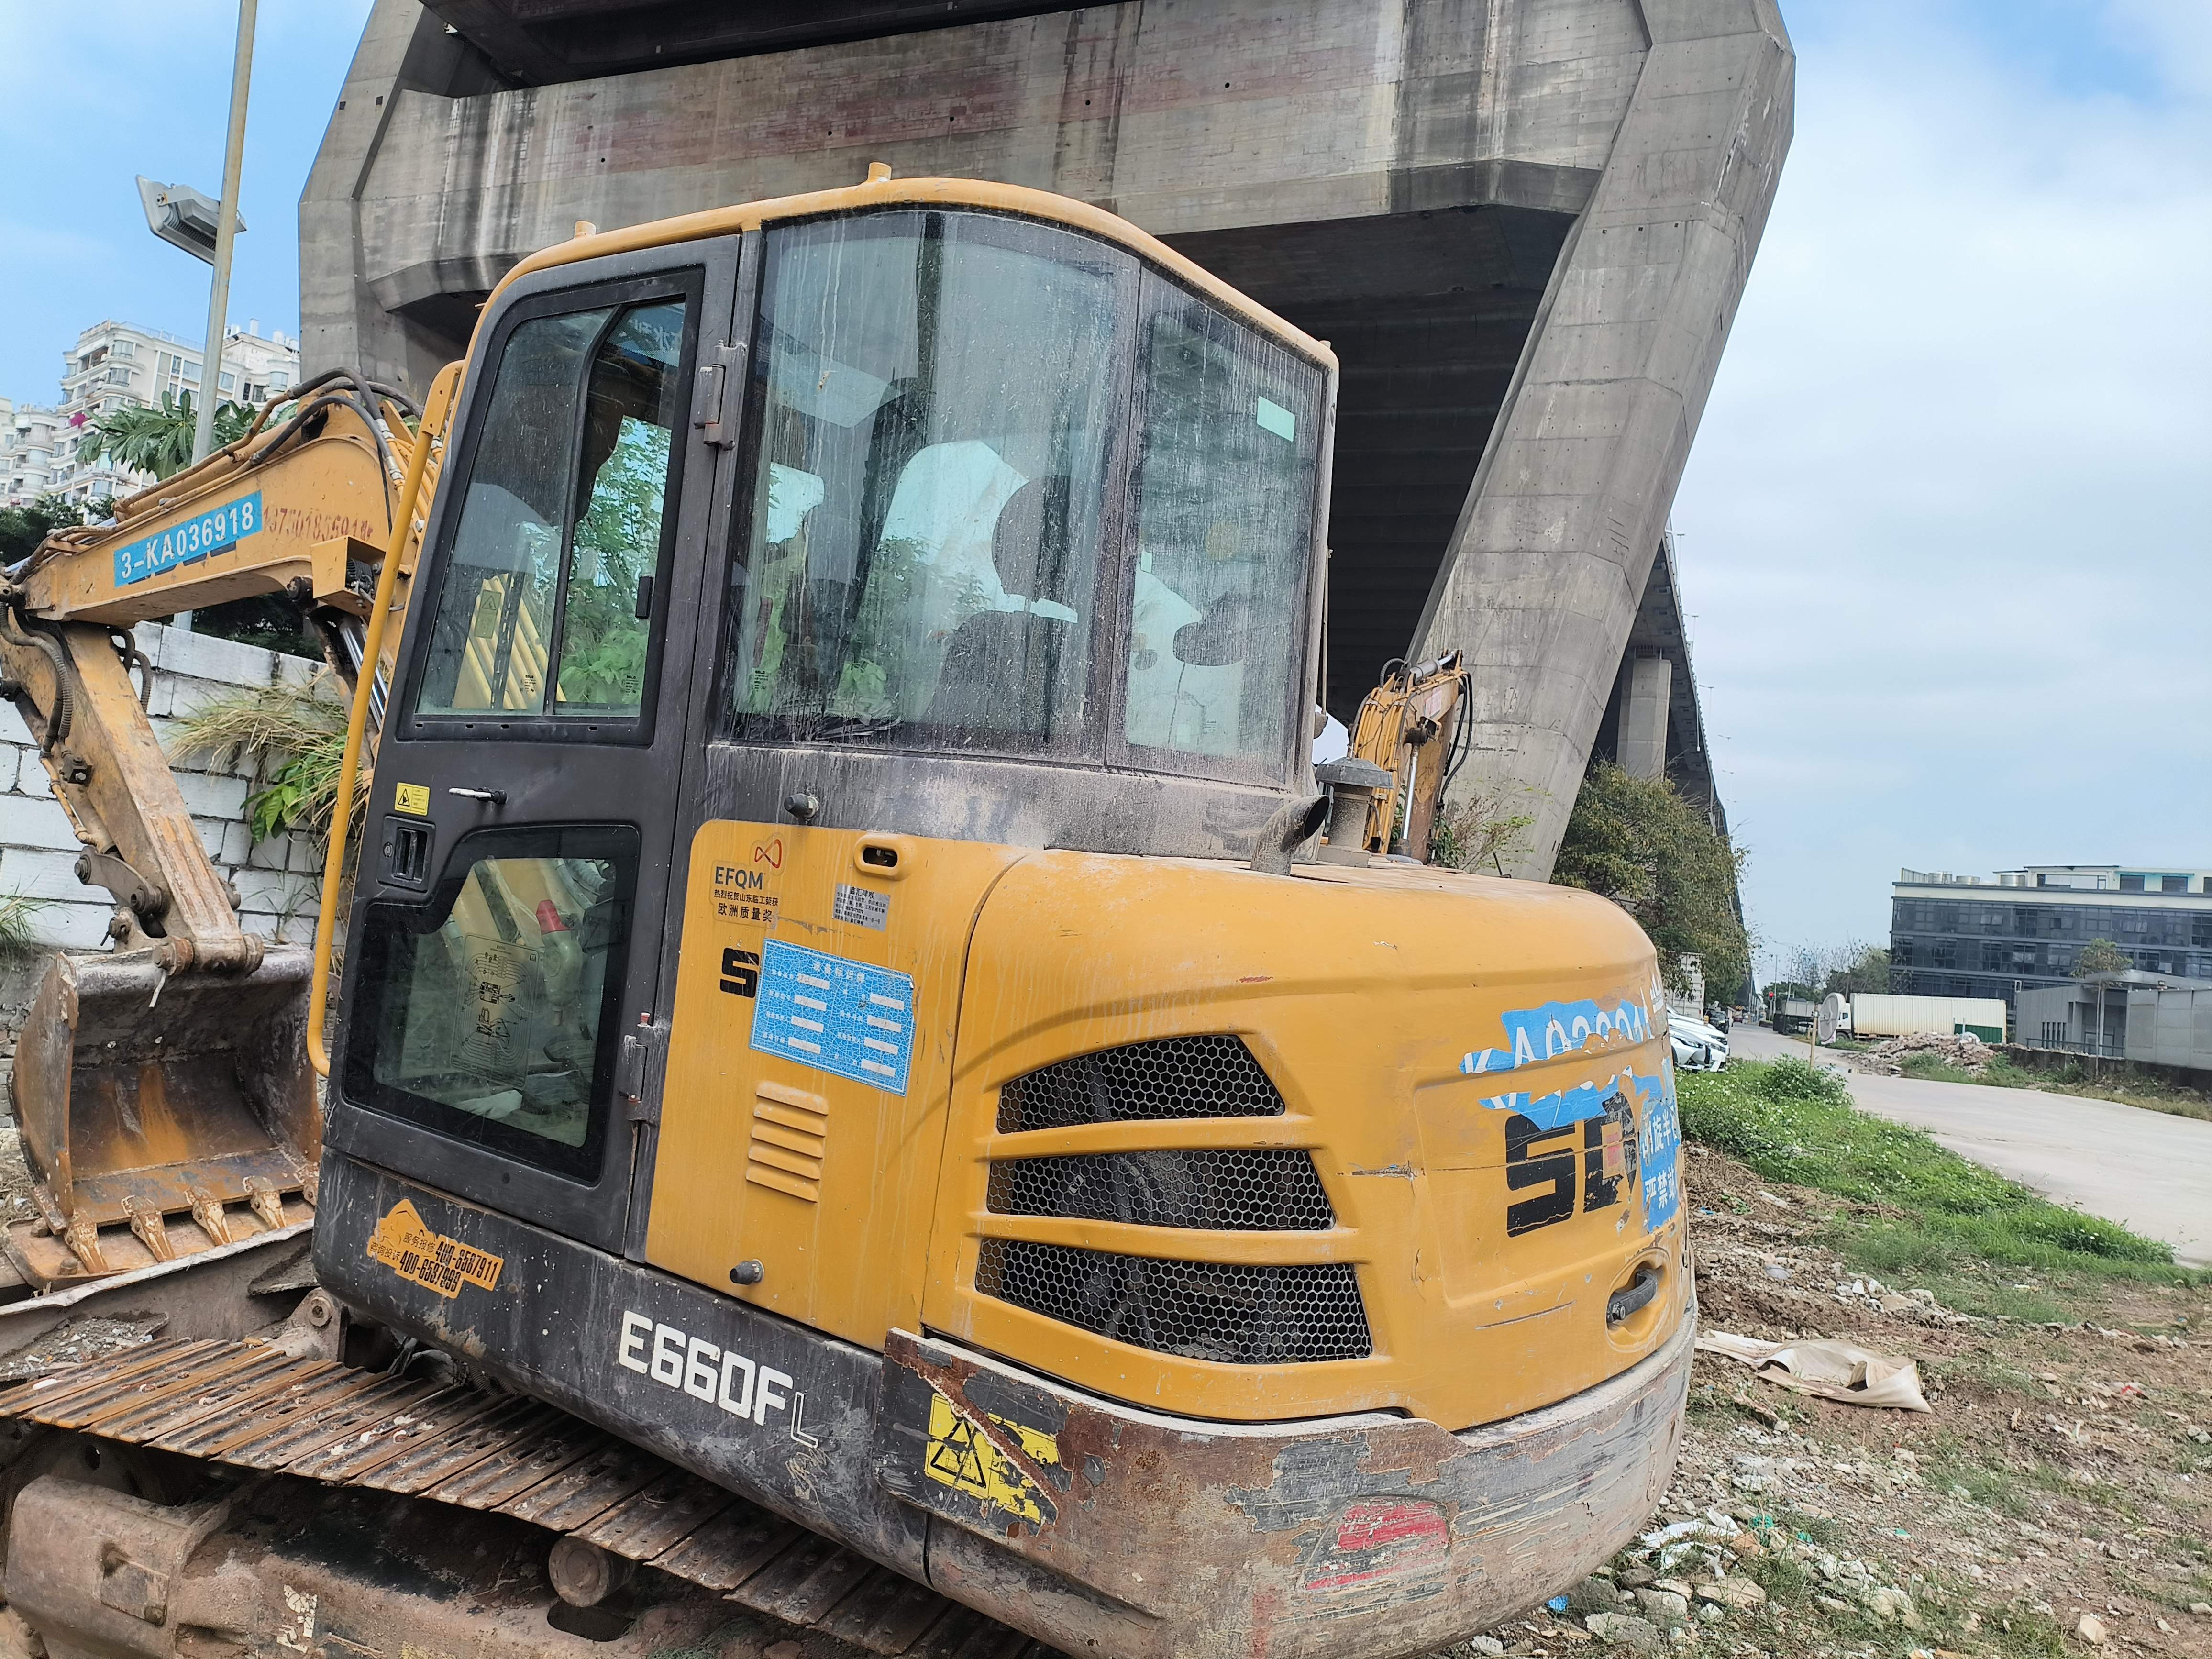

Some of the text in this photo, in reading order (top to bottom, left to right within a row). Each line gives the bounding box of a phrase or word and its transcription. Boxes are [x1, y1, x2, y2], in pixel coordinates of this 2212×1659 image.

[122, 502, 253, 578] 3-KA036918
[715, 866, 763, 890] EFQM
[714, 889, 779, 907] 热烈祝贺山东临工荣获
[718, 903, 773, 922] 欧洲质量奖
[402, 1232, 436, 1253] 服务报修
[370, 1241, 461, 1292] 咨询投诉 400-6587999
